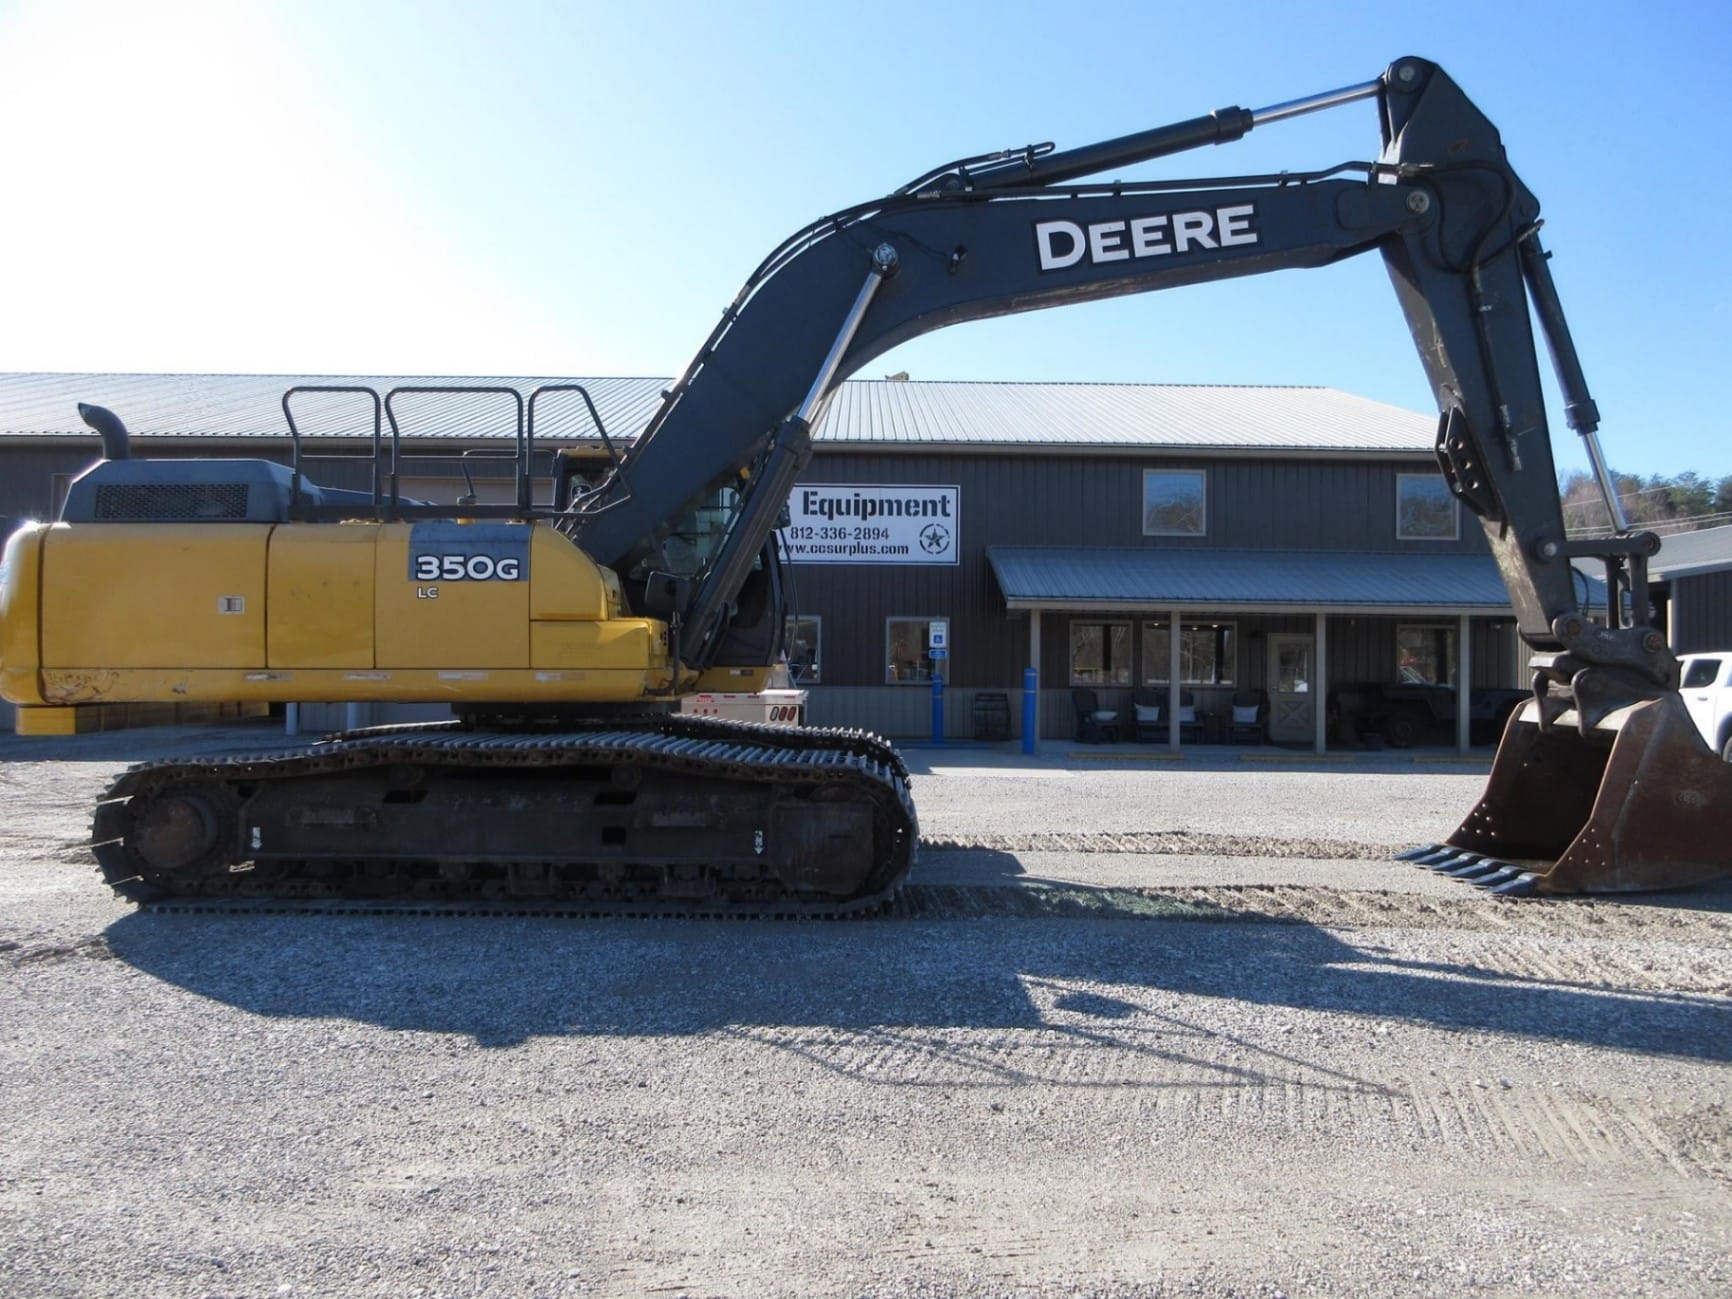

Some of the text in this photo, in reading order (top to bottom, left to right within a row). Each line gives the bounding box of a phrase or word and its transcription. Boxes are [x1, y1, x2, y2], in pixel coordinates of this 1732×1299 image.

[1035, 204, 1258, 271] DEERE
[802, 490, 951, 521] Equipment
[790, 526, 890, 540] 812-336-2894
[778, 541, 909, 556] ww.ccsurplus.com
[416, 554, 519, 581] 350G
[417, 587, 438, 599] LC
